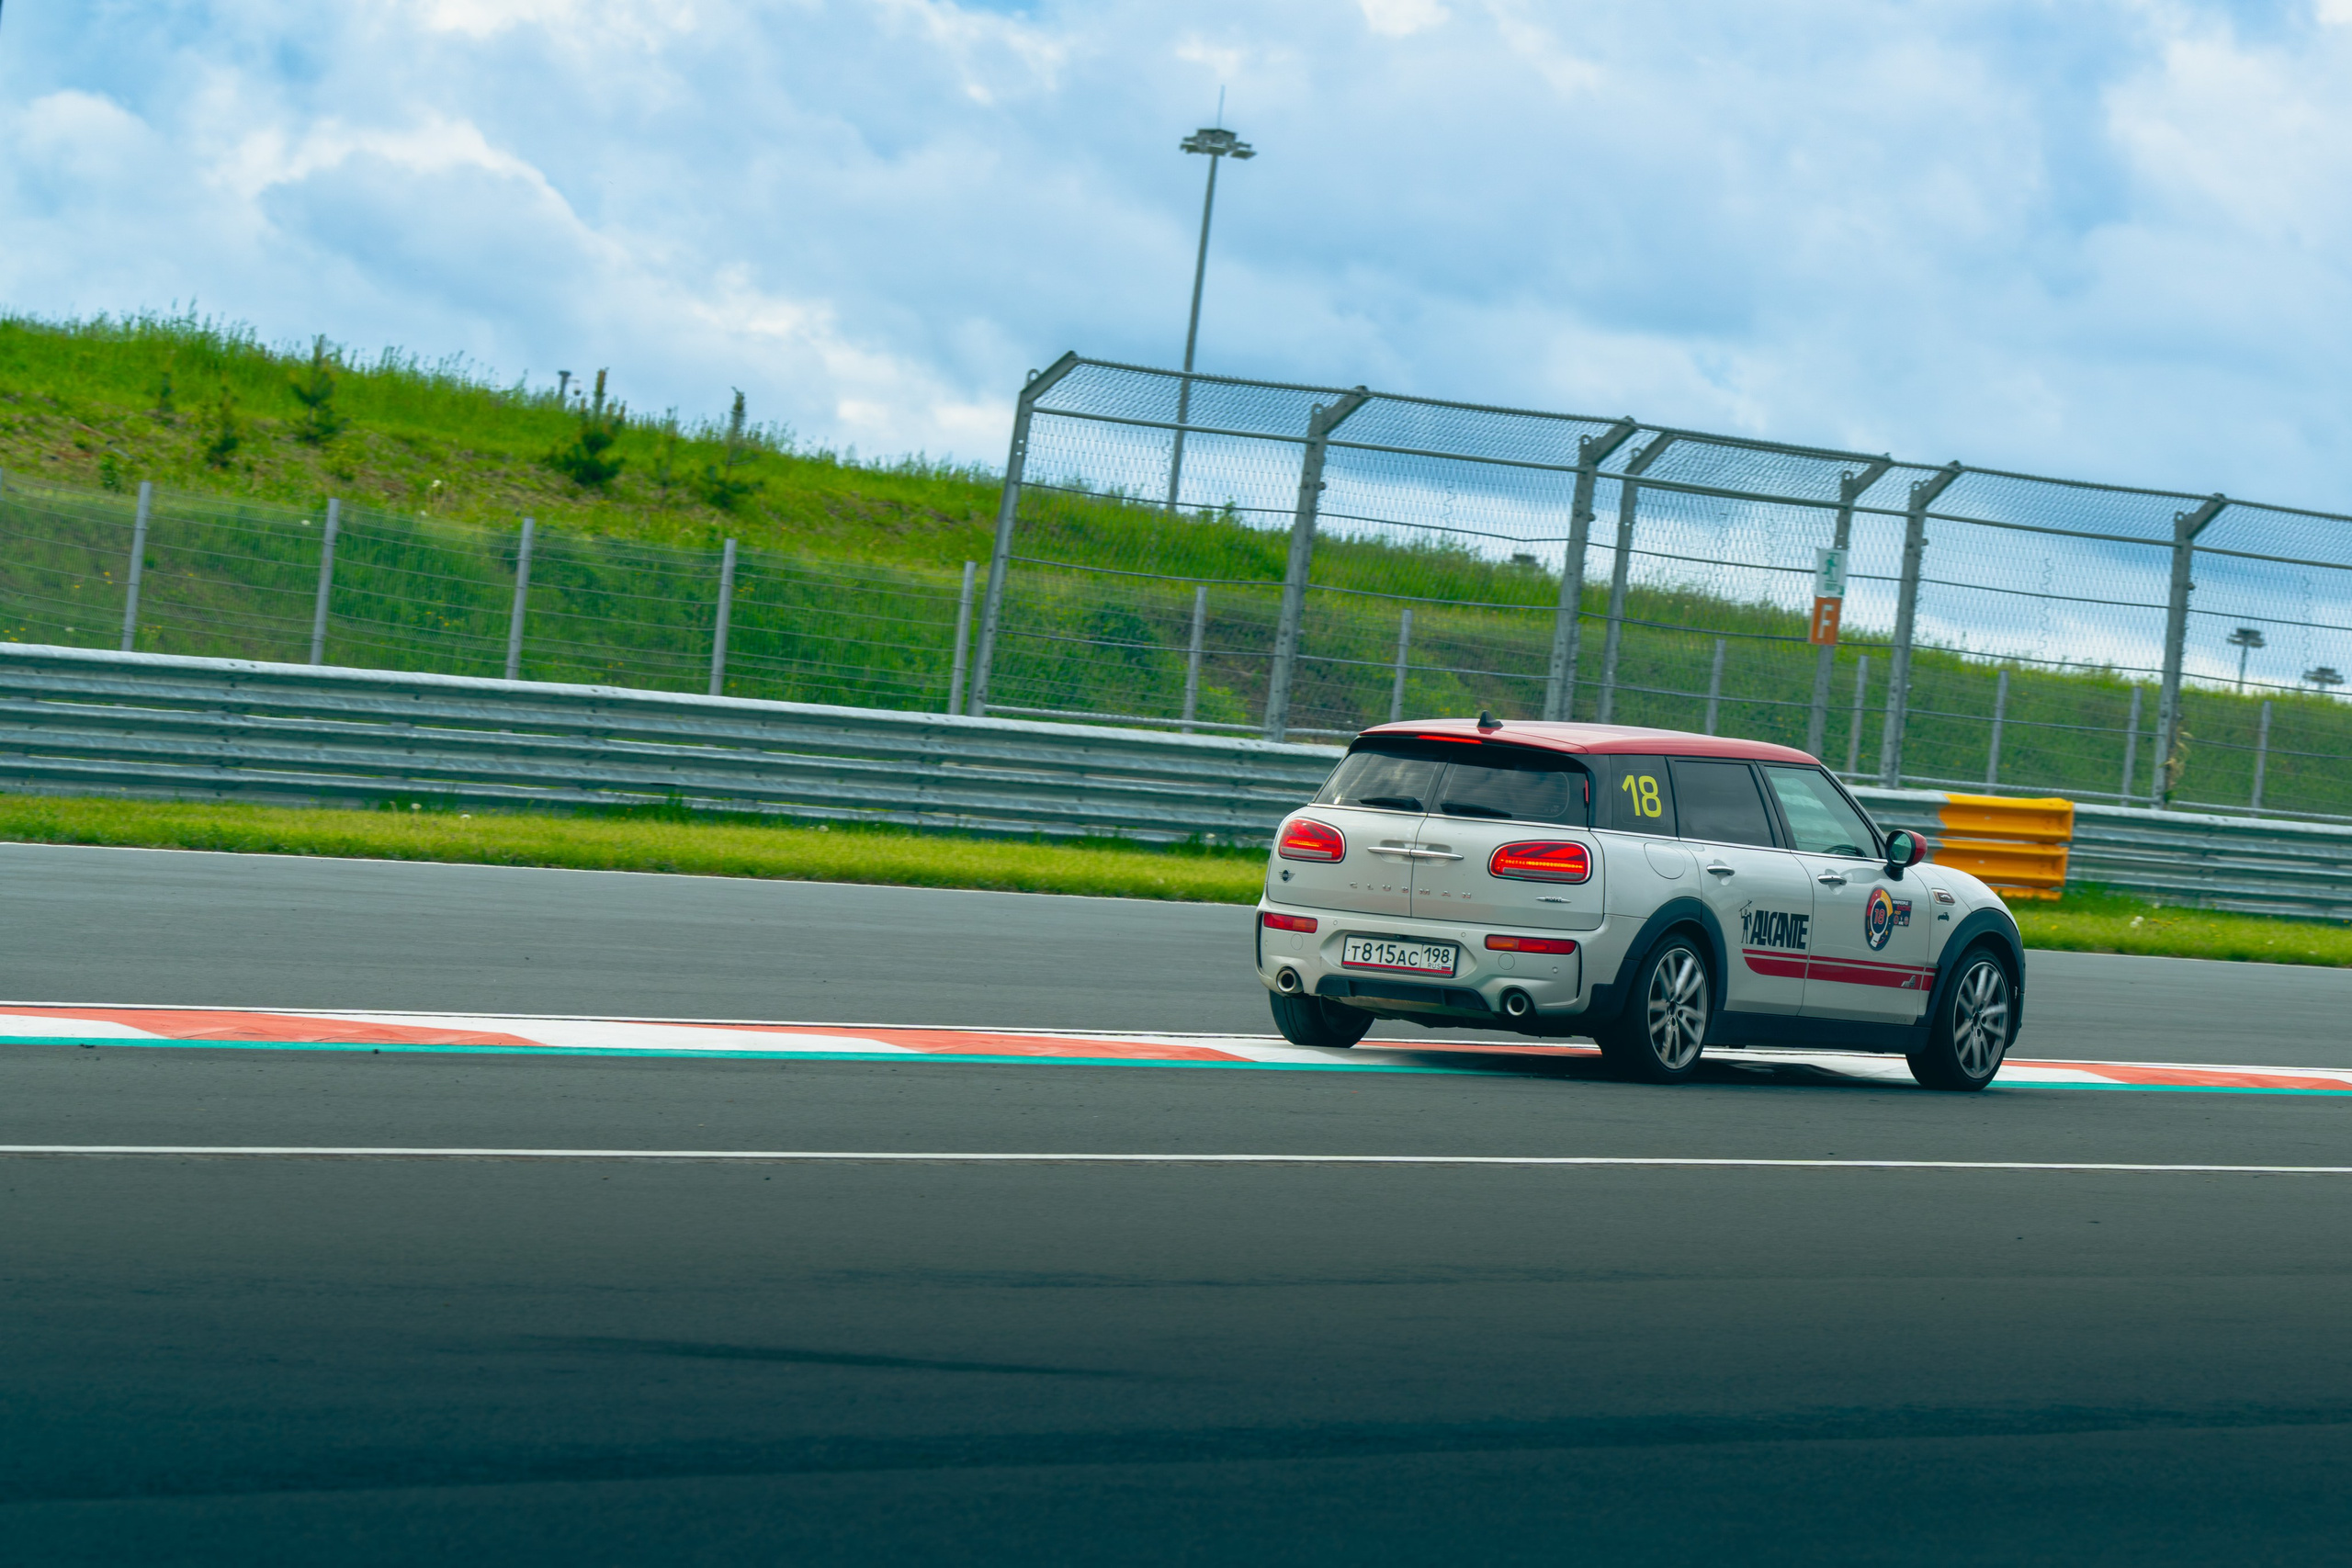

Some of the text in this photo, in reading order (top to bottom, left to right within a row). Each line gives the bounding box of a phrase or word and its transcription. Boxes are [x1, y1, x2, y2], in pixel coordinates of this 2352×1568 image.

[1816, 604, 1835, 639] F
[1622, 774, 1662, 818] 18
[1349, 881, 1472, 899] CLUBMAN
[1749, 909, 1810, 950] ALICANTE
[1873, 908, 1886, 925] 18
[1424, 947, 1451, 964] 198
